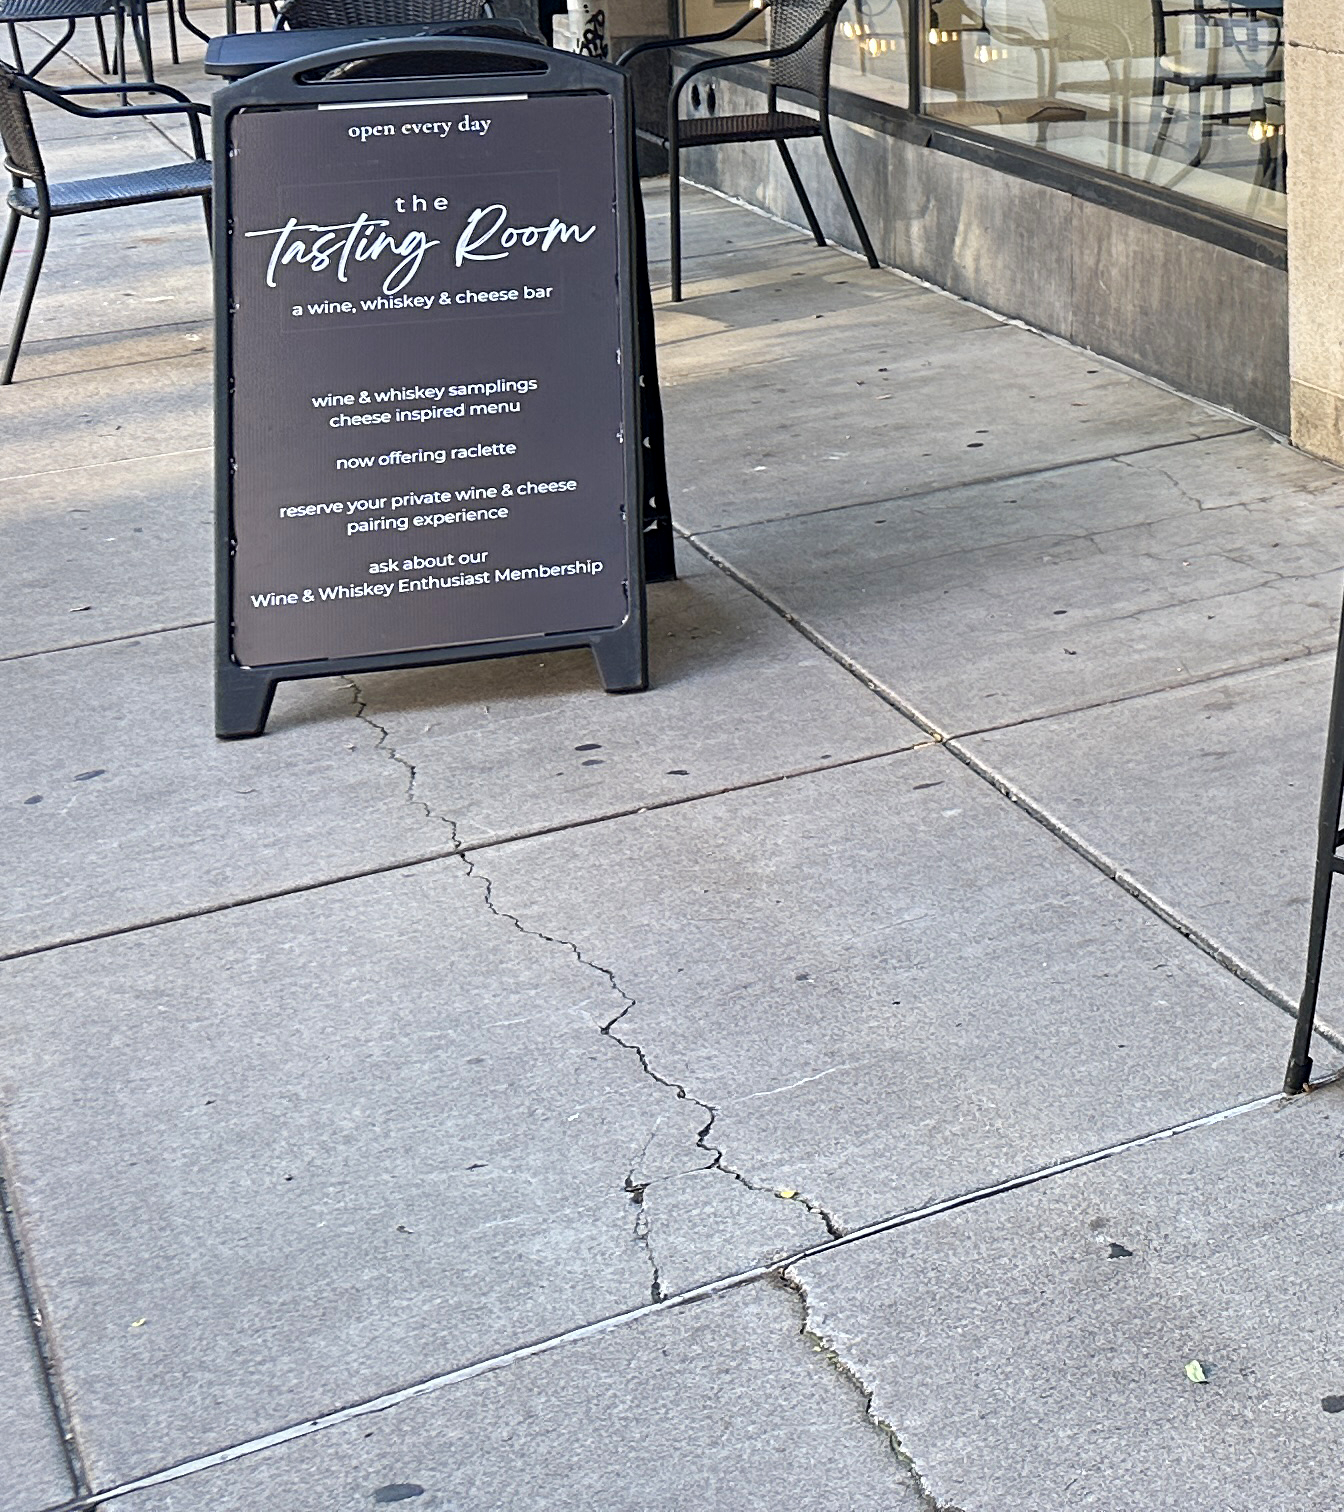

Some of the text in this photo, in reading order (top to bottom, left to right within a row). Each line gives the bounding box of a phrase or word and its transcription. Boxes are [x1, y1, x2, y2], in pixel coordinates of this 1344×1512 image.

[348, 114, 492, 142] open every day
[394, 194, 449, 213] the
[455, 204, 597, 268] Room
[291, 285, 554, 317] a wine, whiskey & cheese bar
[311, 378, 538, 408] wine & whiskey samplings
[329, 401, 521, 428] cheese inspired menu
[336, 443, 517, 470] now offering raclette
[279, 480, 577, 519] reserve your private wine & cheese
[347, 507, 509, 537] pairing experience
[368, 551, 489, 574] ask about our
[250, 559, 604, 608] Wine & Whiskey Enthusiast Membership
